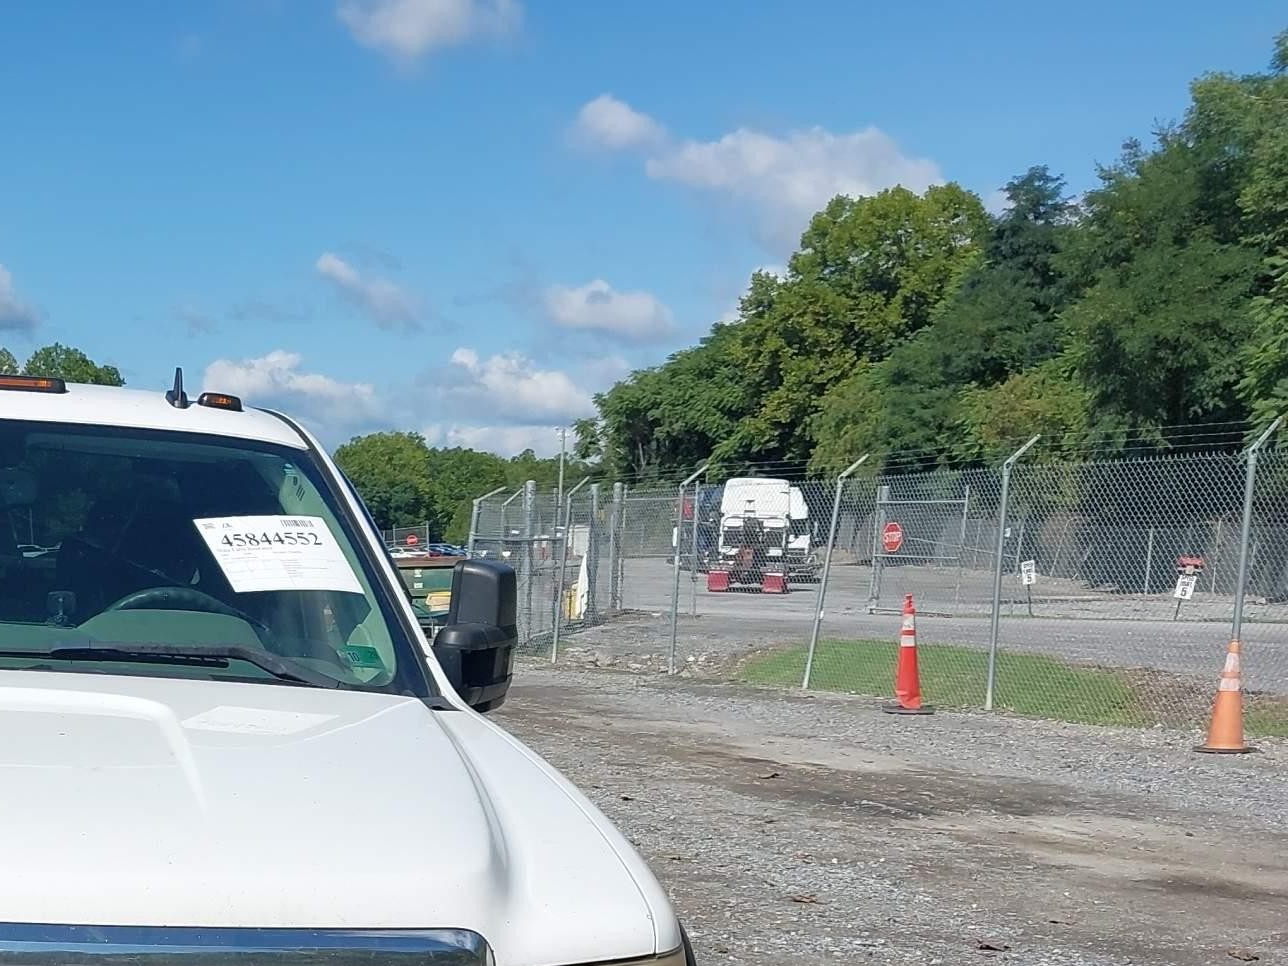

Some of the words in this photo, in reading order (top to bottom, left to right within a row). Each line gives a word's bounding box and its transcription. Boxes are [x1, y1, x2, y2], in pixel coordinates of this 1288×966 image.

[221, 532, 323, 547] 45844552
[885, 531, 902, 543] STOP
[1027, 574, 1032, 583] 5
[1180, 587, 1188, 597] 5
